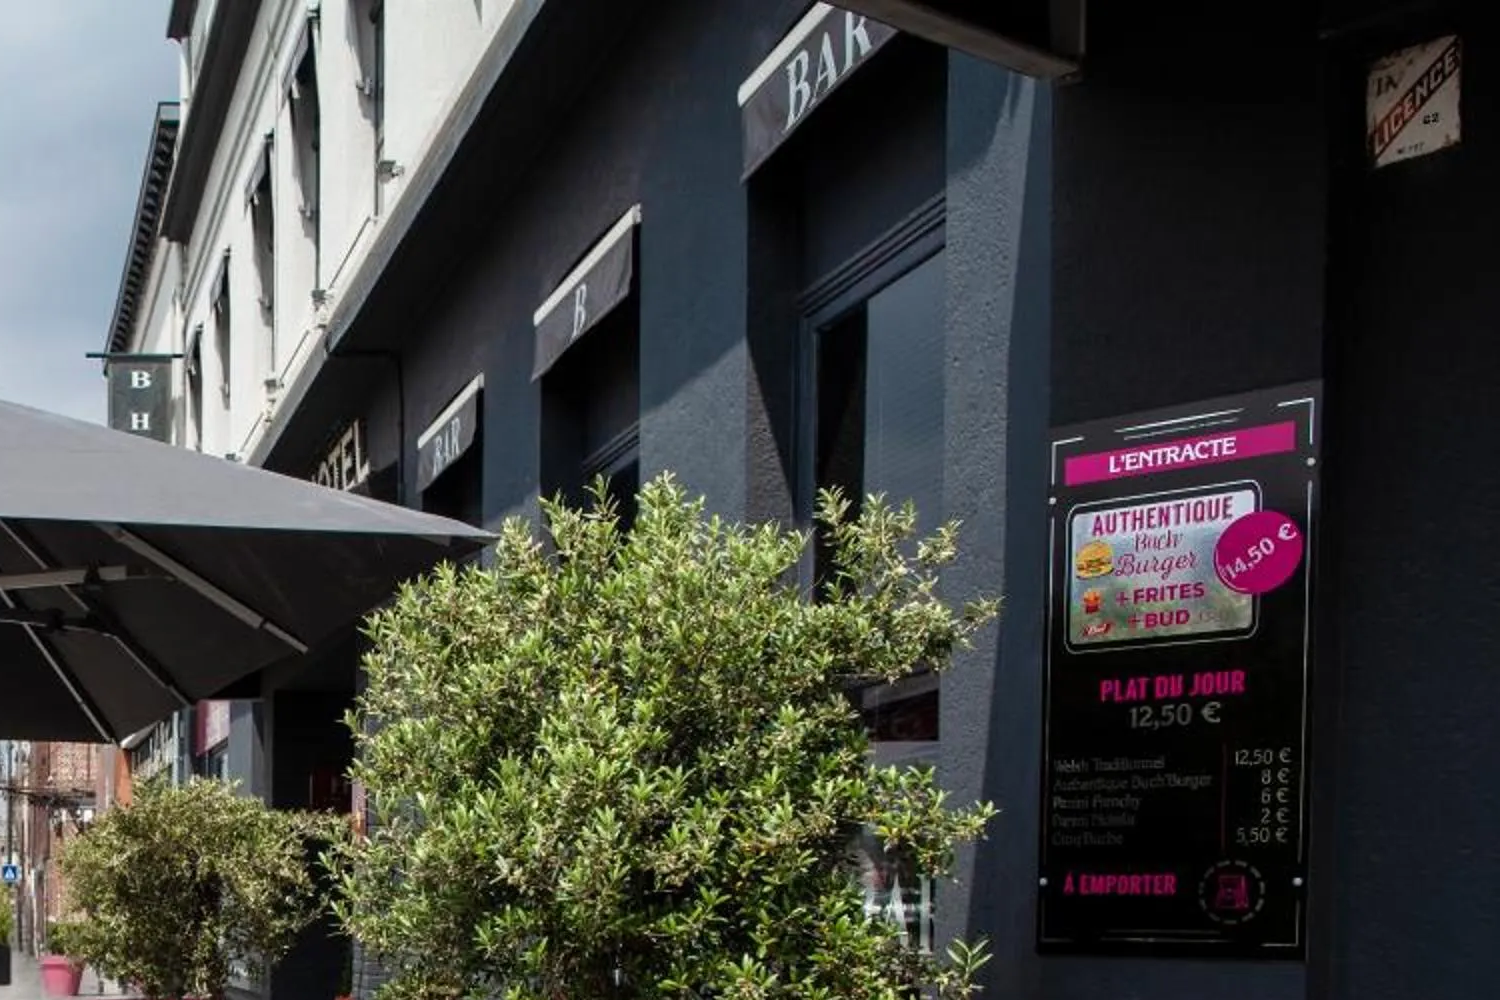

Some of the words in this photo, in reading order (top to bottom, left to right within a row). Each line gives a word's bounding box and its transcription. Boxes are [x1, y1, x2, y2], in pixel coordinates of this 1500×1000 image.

[783, 11, 872, 133] BAR
[1374, 46, 1457, 155] LICENCE
[311, 417, 372, 492] OTEL
[432, 417, 461, 478] BAR
[1108, 436, 1237, 474] L'ENTRACTE
[1091, 495, 1235, 538] AUTHENTIQUE
[1277, 522, 1298, 541] €
[1115, 551, 1197, 580] Burger
[1100, 676, 1150, 703] PLAT
[1154, 673, 1184, 701] DU
[1188, 669, 1246, 697] JOUR
[1128, 703, 1193, 730] 12,50
[1200, 700, 1222, 724] €
[1234, 748, 1273, 766] 12,50
[1279, 747, 1291, 763] €
[1260, 770, 1272, 785] 8
[1276, 768, 1290, 783] €
[1260, 788, 1271, 804] 6
[1276, 787, 1290, 803] €
[1260, 807, 1271, 824] 2
[1275, 807, 1289, 823] €
[1275, 827, 1288, 843] €
[1079, 872, 1177, 896] EMPORTER
